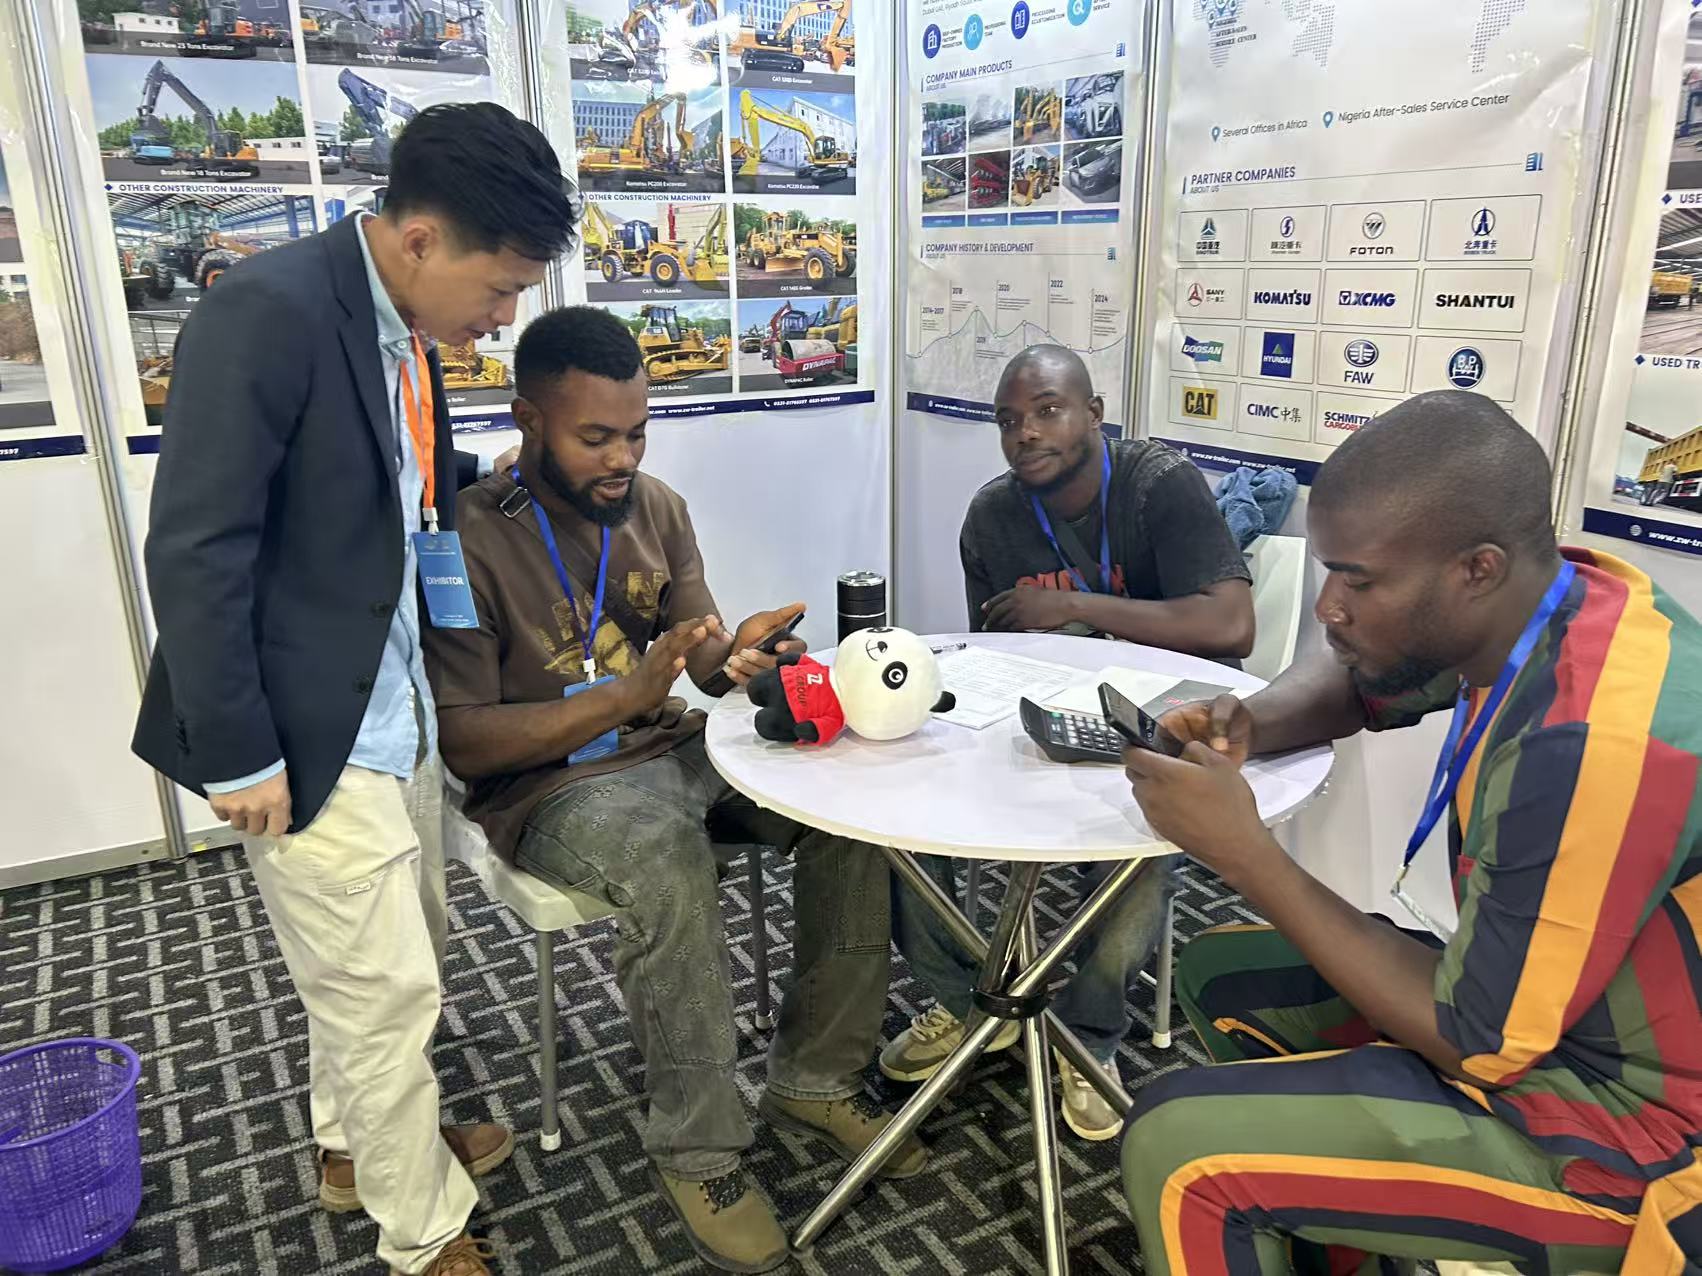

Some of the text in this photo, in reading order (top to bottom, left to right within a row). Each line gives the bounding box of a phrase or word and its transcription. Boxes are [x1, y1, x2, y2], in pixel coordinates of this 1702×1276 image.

[925, 60, 1013, 84] COMPANY MAIN PRODUCTS
[1338, 93, 1511, 124] Nigeria After-Sales Service Center
[1222, 126, 1249, 138] Several
[1250, 124, 1276, 135] Offices
[1285, 119, 1308, 130] Africa
[1191, 166, 1297, 186] PARTNER COMPANIES
[119, 184, 284, 194] OTHER CONSTRUCTION MACHINERY
[1190, 186, 1210, 195] ABOUT
[925, 243, 958, 253] COMPANY
[958, 243, 984, 253] HISTORY
[989, 243, 1034, 252] DEVELOPMENT
[1349, 246, 1394, 256] FOTON
[1050, 280, 1064, 288] 2022
[1094, 294, 1109, 303] 2024
[1205, 288, 1225, 296] SANY
[1253, 289, 1312, 306] KOMATSU
[1351, 292, 1396, 307] XCMG
[1435, 293, 1515, 309] SHANTUI
[1183, 345, 1222, 355] DOOSAN
[1263, 354, 1292, 365] HYUNDAI
[1652, 356, 1682, 368] USED
[1343, 370, 1375, 385] FAW
[1184, 390, 1215, 417] CAT
[1247, 403, 1279, 419] CIMC
[1280, 406, 1302, 424] 中集
[1324, 411, 1372, 425] SCHMITZ
[425, 576, 465, 586] EXHIBITOR
